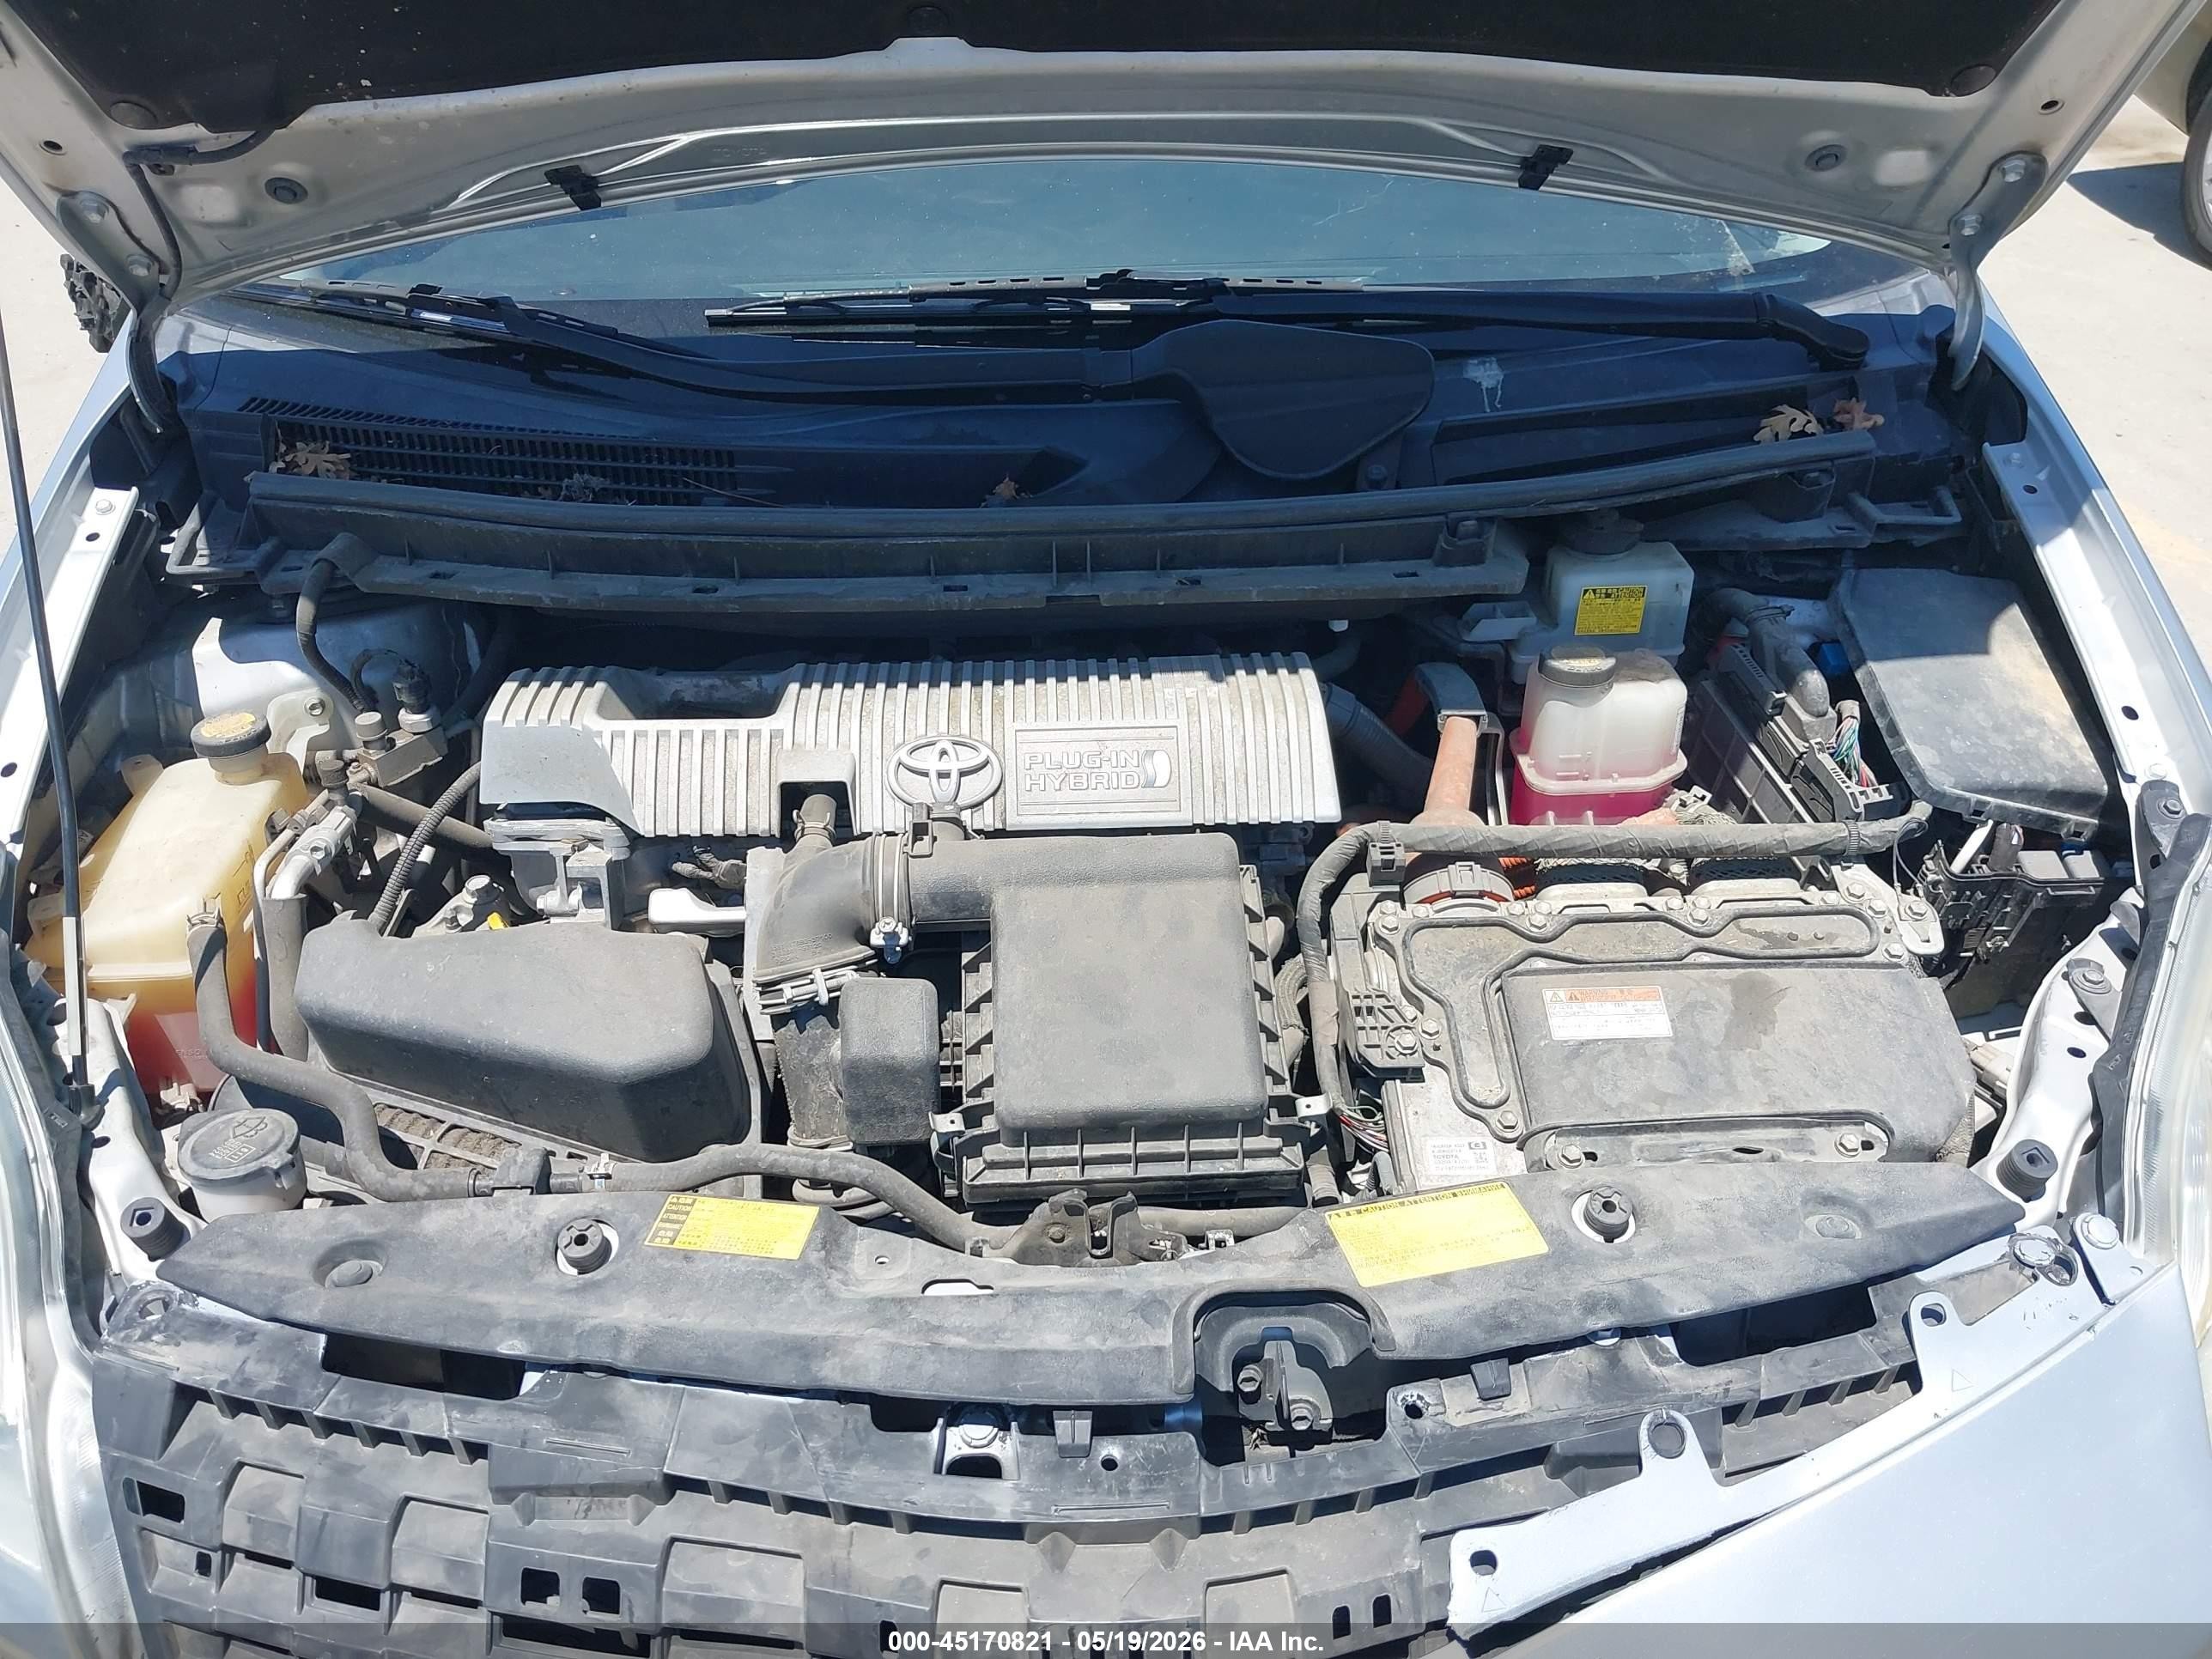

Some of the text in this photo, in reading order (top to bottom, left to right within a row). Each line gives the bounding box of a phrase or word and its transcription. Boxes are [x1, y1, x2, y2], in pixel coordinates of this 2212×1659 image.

[1024, 750, 1139, 770] PLUG-IN
[1024, 771, 1140, 792] HYBRID
[1361, 1202, 1399, 1213] CAUTION
[1405, 1192, 1452, 1206] ATTENTION
